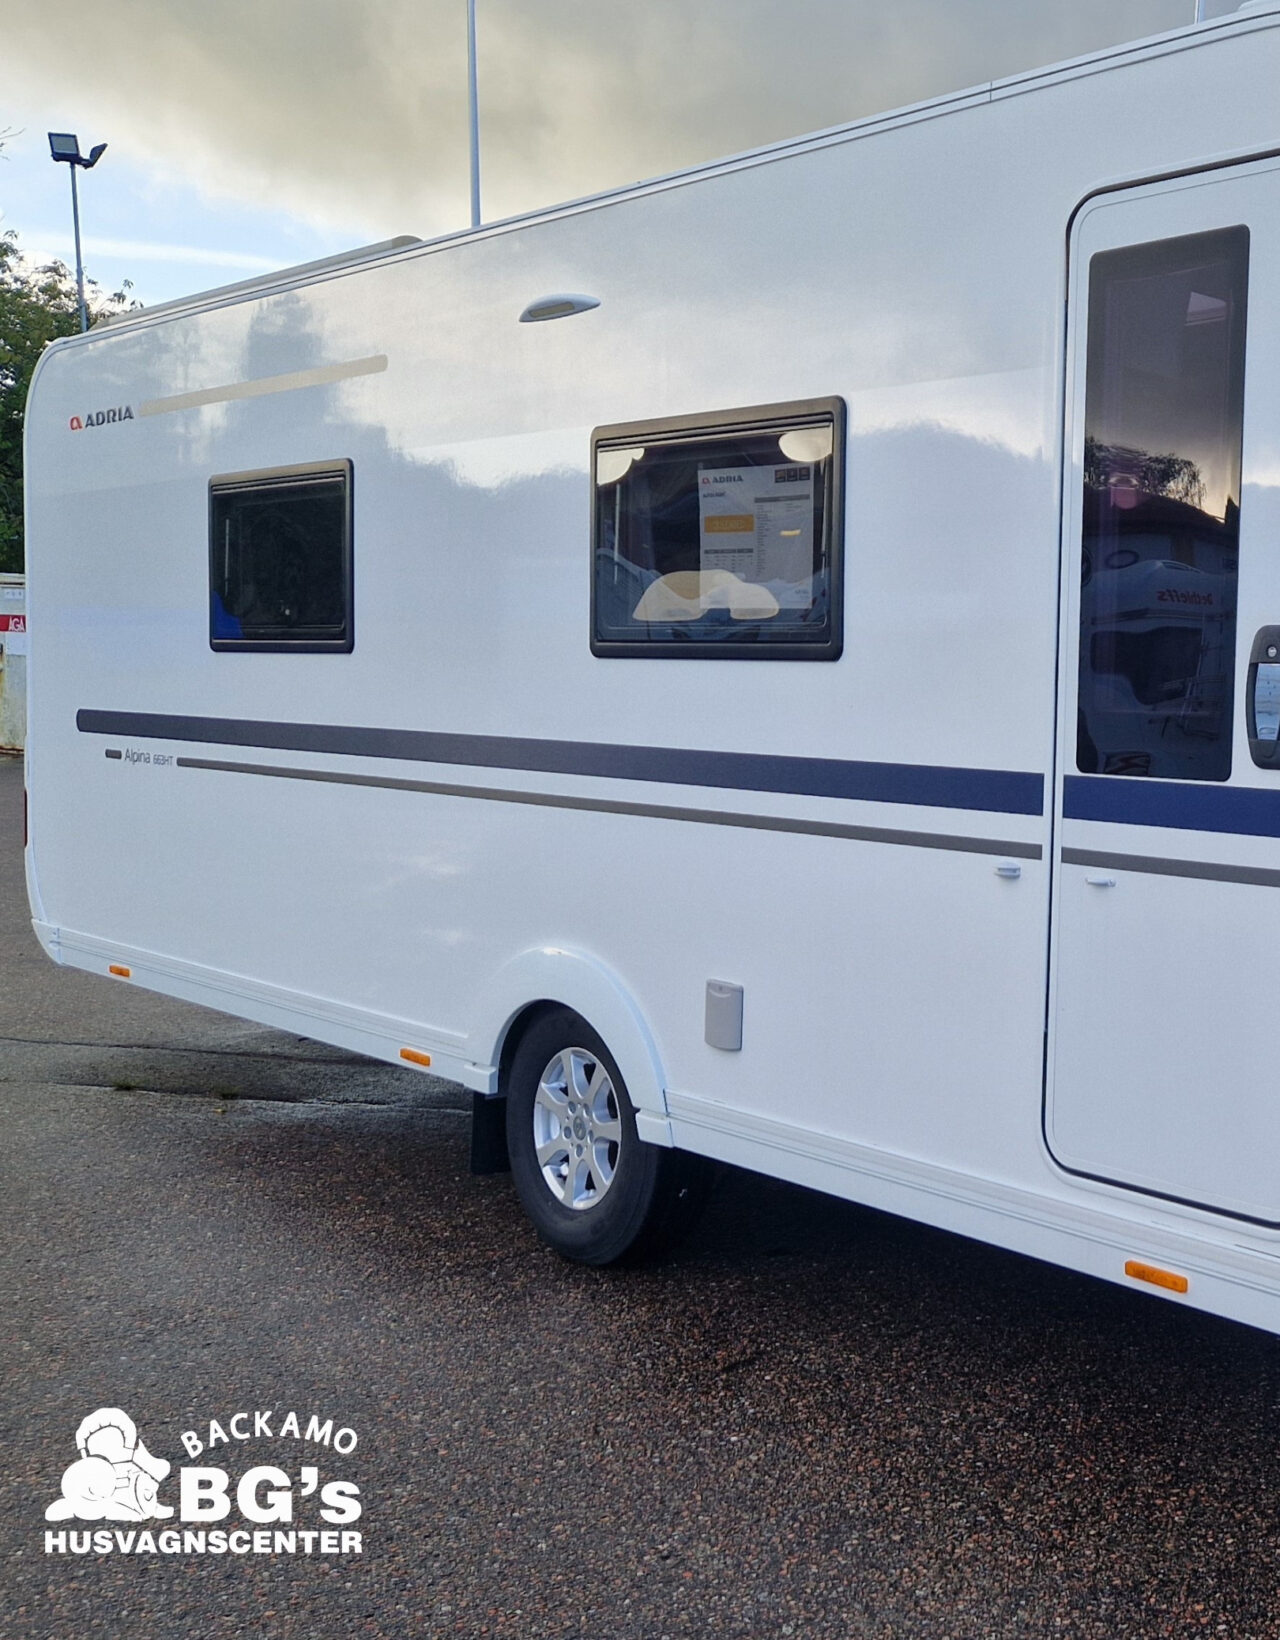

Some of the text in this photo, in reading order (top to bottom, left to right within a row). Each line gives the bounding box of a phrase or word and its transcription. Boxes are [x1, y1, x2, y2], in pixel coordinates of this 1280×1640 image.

[85, 406, 134, 428] ADRIA
[712, 475, 744, 484] ADRIA
[124, 748, 150, 765] Alpina
